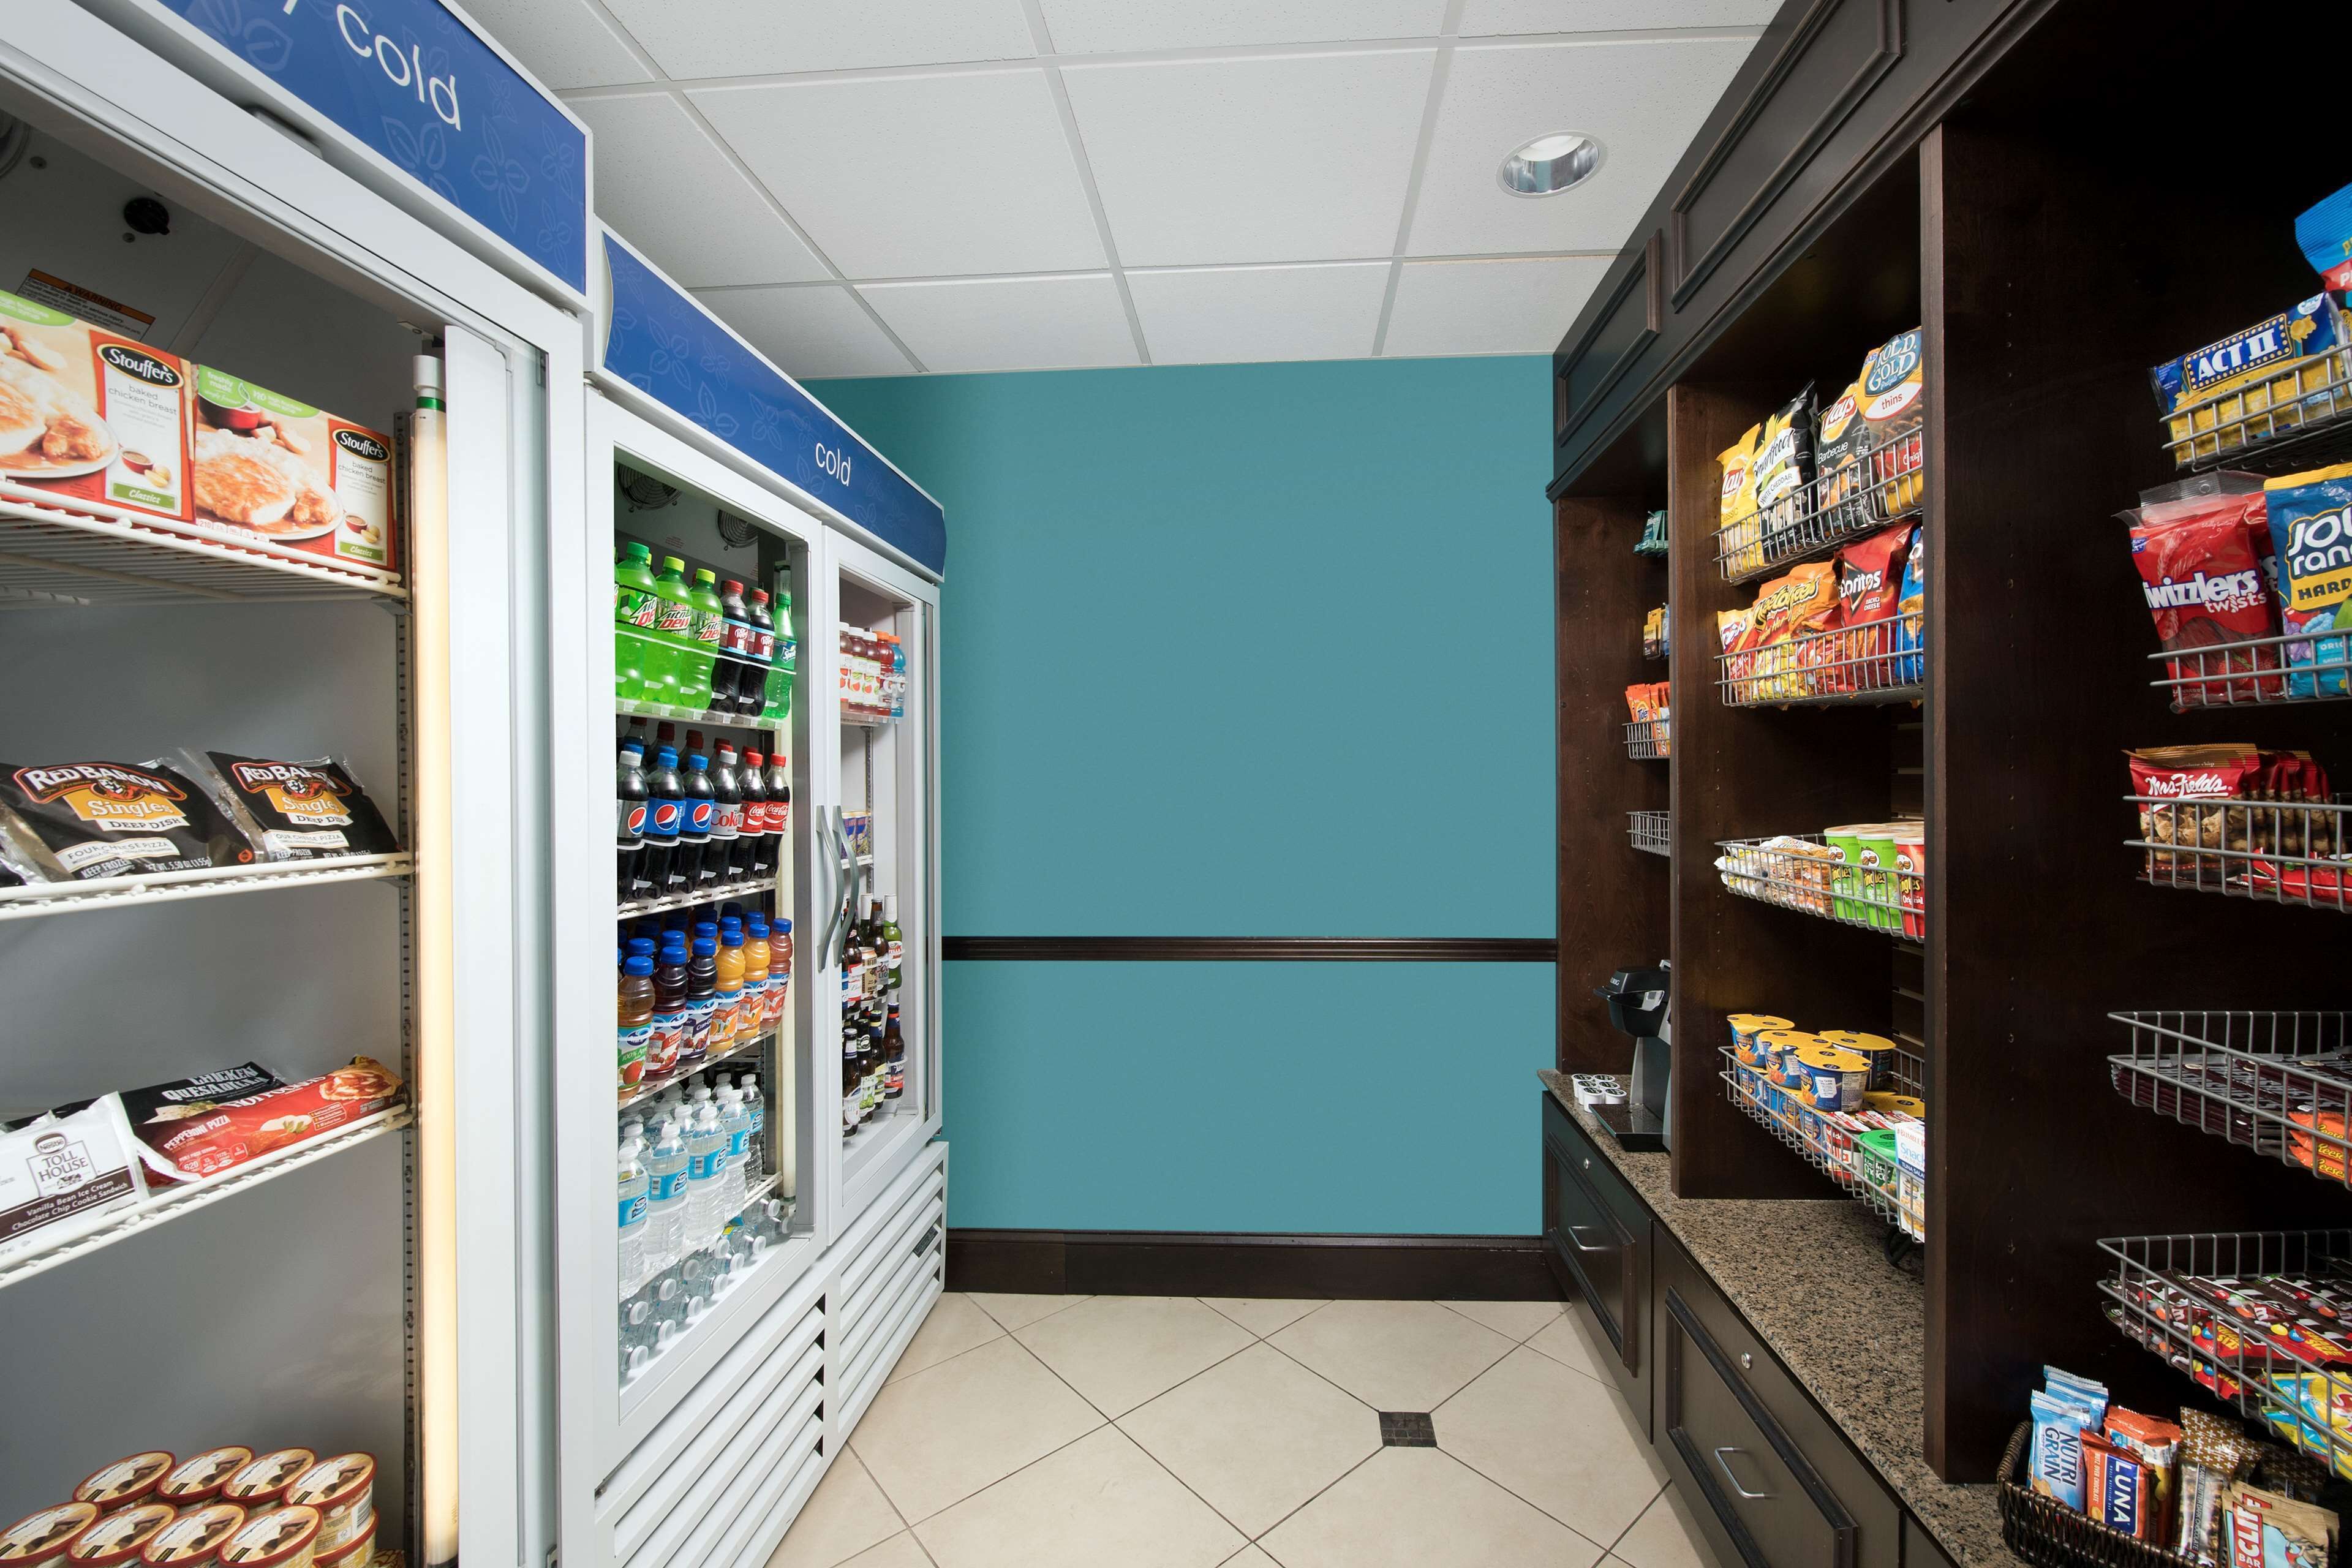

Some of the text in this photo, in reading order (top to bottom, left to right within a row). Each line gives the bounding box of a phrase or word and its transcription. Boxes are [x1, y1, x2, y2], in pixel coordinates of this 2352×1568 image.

[336, 4, 461, 131] cold
[108, 347, 174, 384] Stouffer's
[2198, 328, 2278, 381] ACT II
[1868, 351, 1916, 391] GOLD
[108, 386, 146, 405] chicken
[148, 400, 177, 416] breast
[128, 384, 158, 400] baked
[1882, 393, 1903, 410] thins
[1825, 391, 1856, 432] Lay's
[340, 432, 384, 458] Stouffer's
[1818, 442, 1849, 464] Barbecue
[815, 442, 851, 486] cold
[365, 473, 386, 484] breast
[1770, 472, 1793, 491] CHEDDAR
[129, 489, 161, 503] Classics
[2288, 507, 2352, 557] JOL
[2293, 546, 2351, 576] ran
[1839, 570, 1883, 599] Doritos
[2297, 578, 2351, 601] HARD
[1864, 602, 1881, 612] CHEESE
[2205, 592, 2267, 613] twists
[1637, 707, 1648, 719] Tide
[24, 769, 81, 791] RED
[74, 766, 169, 793] BARON
[239, 766, 273, 783] RED
[2145, 773, 2228, 798] Mrs. Fields
[88, 800, 174, 818] Singles
[149, 818, 181, 829] DISH
[81, 862, 103, 878] KEEP
[163, 1114, 232, 1151] PEPPERONI PIZZA
[41, 1150, 78, 1168] TOLL
[184, 1160, 199, 1171] 620
[1901, 1142, 1924, 1163] Snac
[39, 1156, 89, 1183] HOUSE
[1901, 1162, 1913, 1172] TUNA
[11, 1182, 129, 1231] Chocolate Chip Cookie Sandwich
[26, 1180, 114, 1217] Vanilla Bean Ice Cream
[2044, 1427, 2062, 1483] GRAIN
[2059, 1430, 2079, 1487] NUTRI
[2114, 1460, 2132, 1522] LUNA
[2192, 1518, 2202, 1550] CHOCOLATE
[2237, 1506, 2261, 1557] CLIF
[2239, 1552, 2261, 1568] BAR
